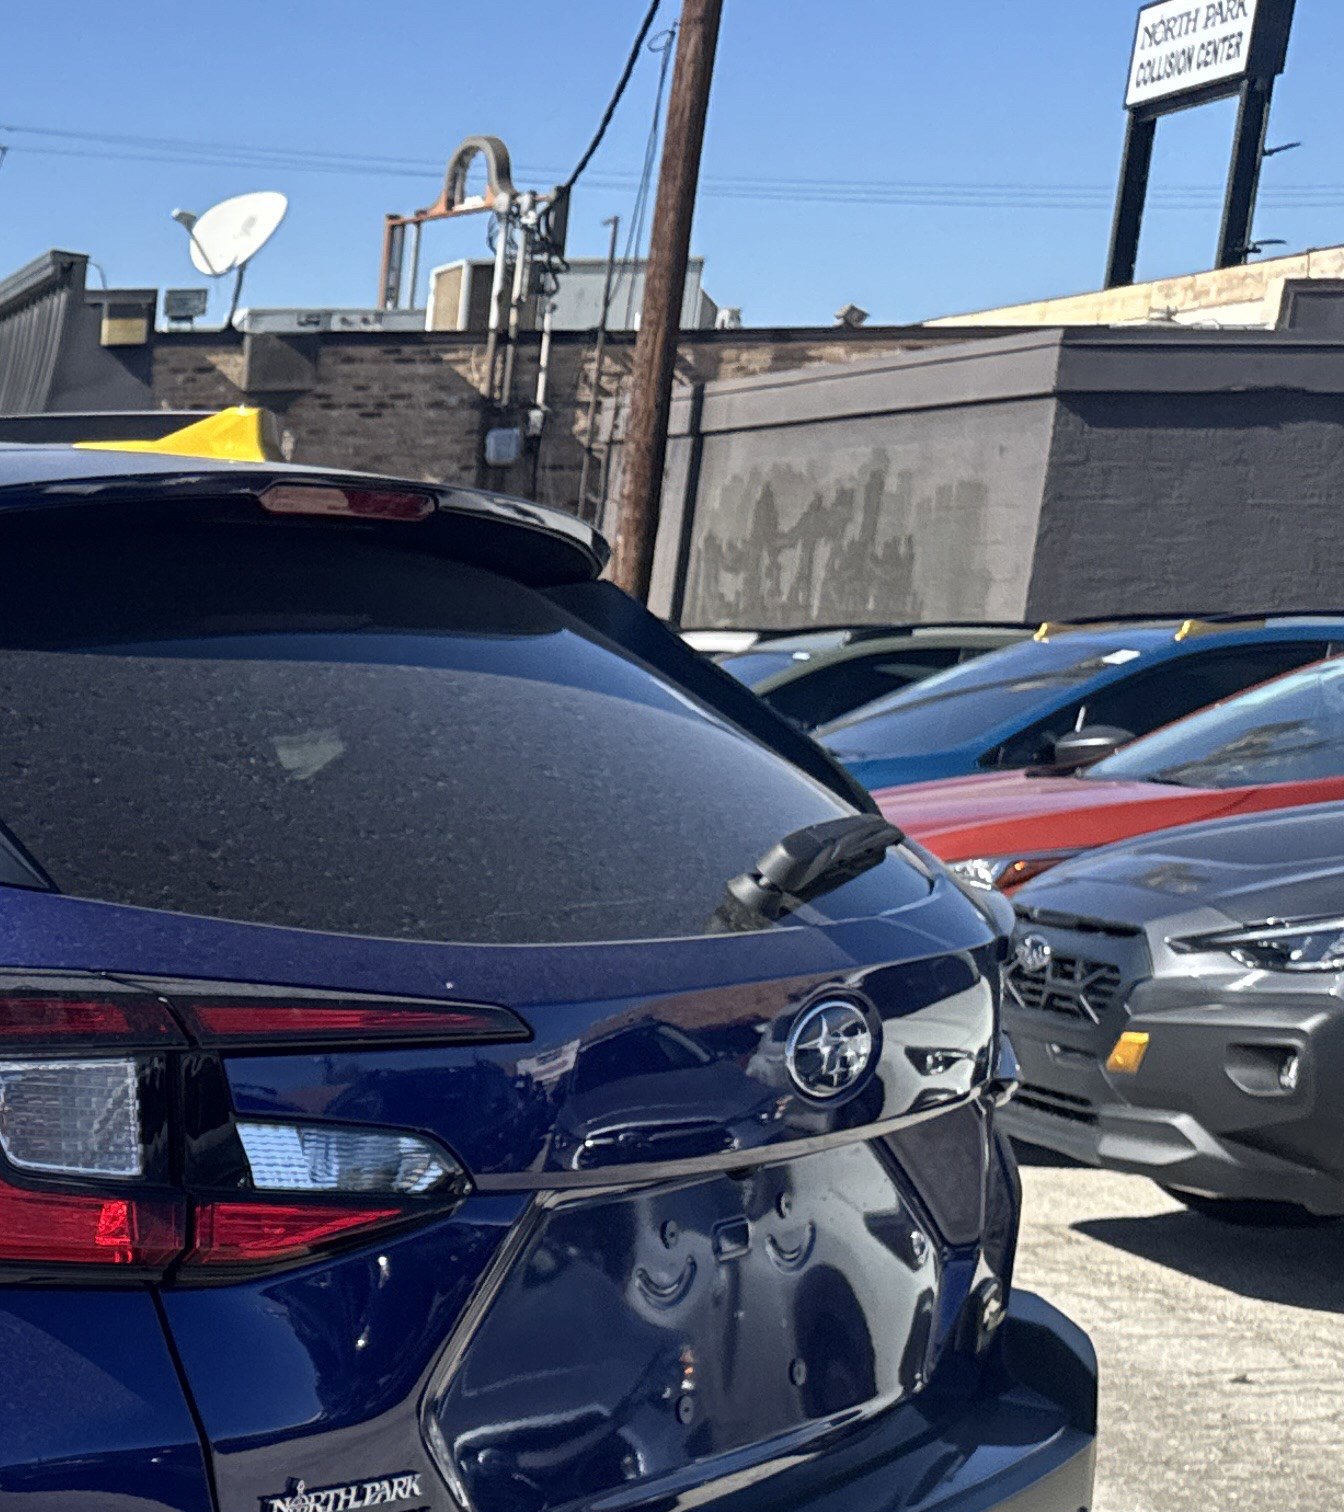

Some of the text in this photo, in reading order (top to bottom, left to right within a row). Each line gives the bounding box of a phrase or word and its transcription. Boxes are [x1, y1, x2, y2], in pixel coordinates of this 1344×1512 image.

[1140, 0, 1248, 50] NORTH PARK
[1135, 31, 1244, 88] COLLISION CENTER
[362, 1474, 423, 1506] PARK
